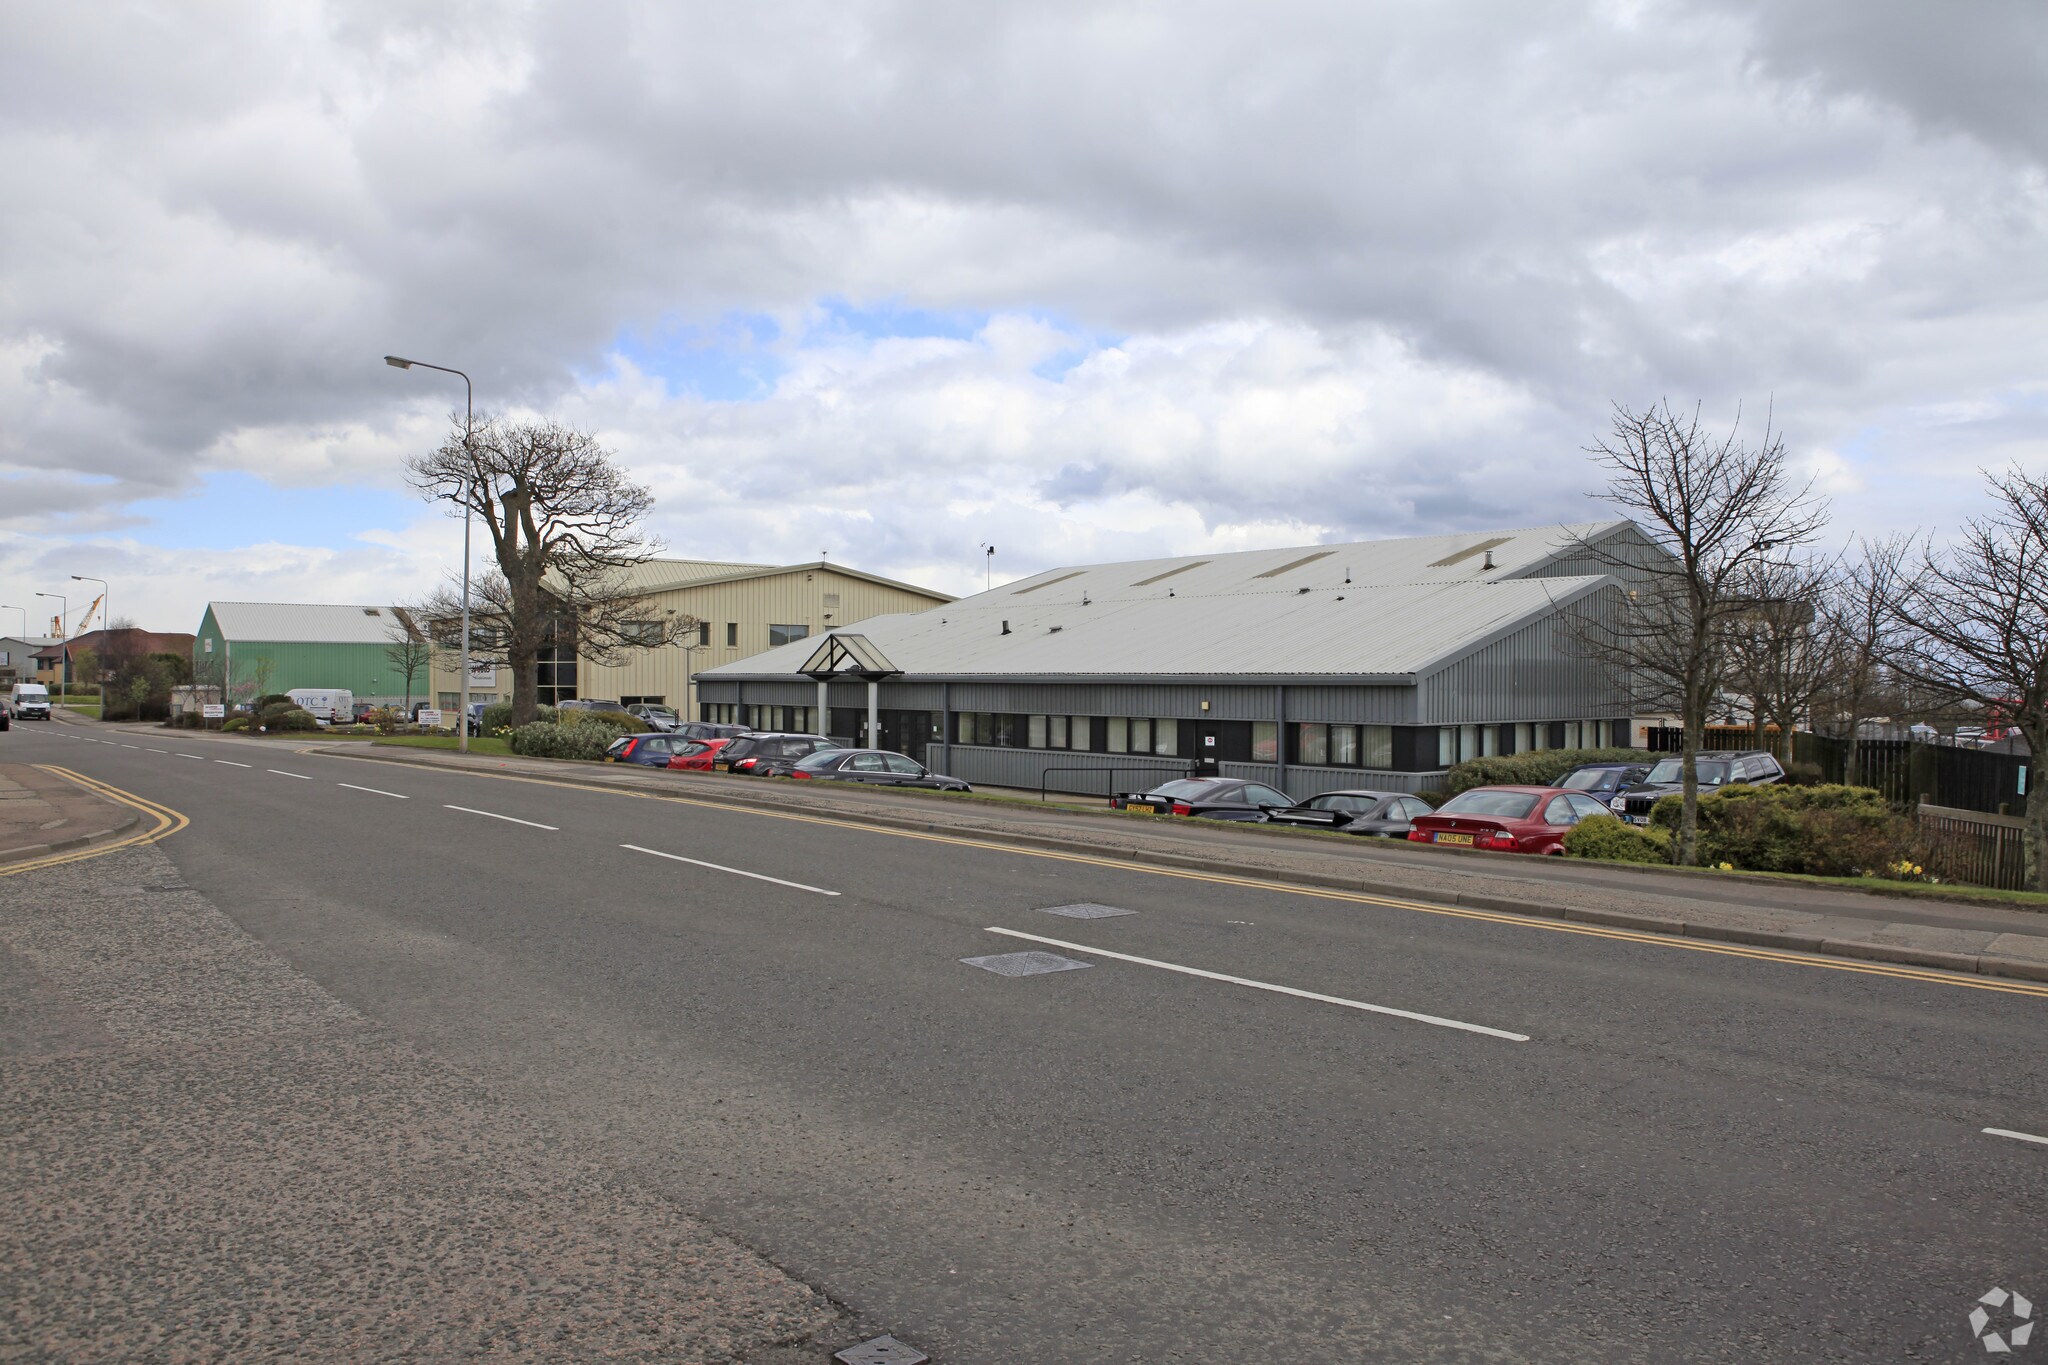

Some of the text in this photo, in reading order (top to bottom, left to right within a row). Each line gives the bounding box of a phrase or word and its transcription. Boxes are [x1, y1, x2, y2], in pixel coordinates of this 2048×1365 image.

[296, 697, 318, 706] OTC
[1439, 832, 1472, 843] NA05 UNE
